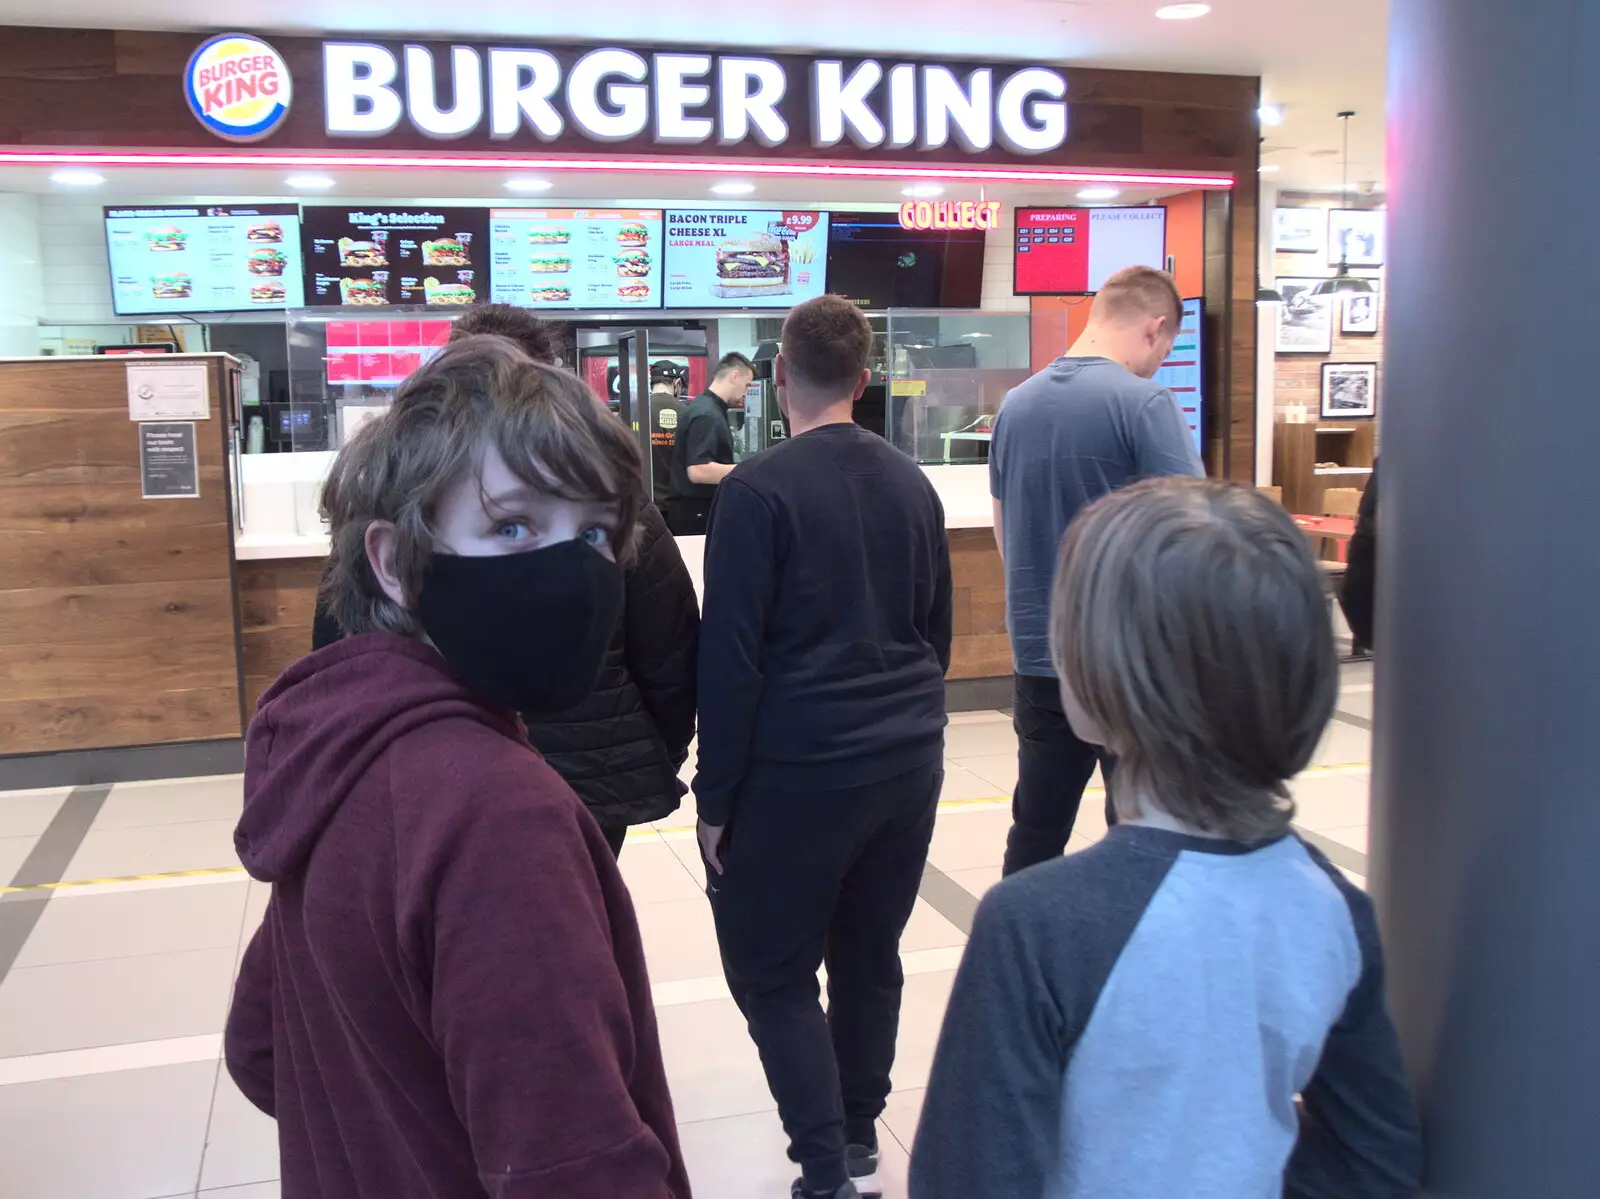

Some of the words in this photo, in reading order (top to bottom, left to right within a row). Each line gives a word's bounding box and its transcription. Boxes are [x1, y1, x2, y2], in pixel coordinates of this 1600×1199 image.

[199, 55, 275, 88] BURGER
[204, 71, 279, 113] KING
[323, 41, 788, 146] BURGER
[810, 58, 1068, 154] KING
[348, 212, 388, 226] King's
[389, 212, 445, 224] Selection
[669, 214, 707, 224] BACON
[709, 215, 748, 224] TRIPLE
[786, 215, 813, 225] £9.99
[899, 200, 1001, 230] COLLECT
[1030, 213, 1077, 221] PREPARING
[1123, 212, 1162, 220] COLLECT
[669, 227, 711, 237] CHEESE
[713, 228, 727, 237] XL
[669, 239, 694, 247] LARGE
